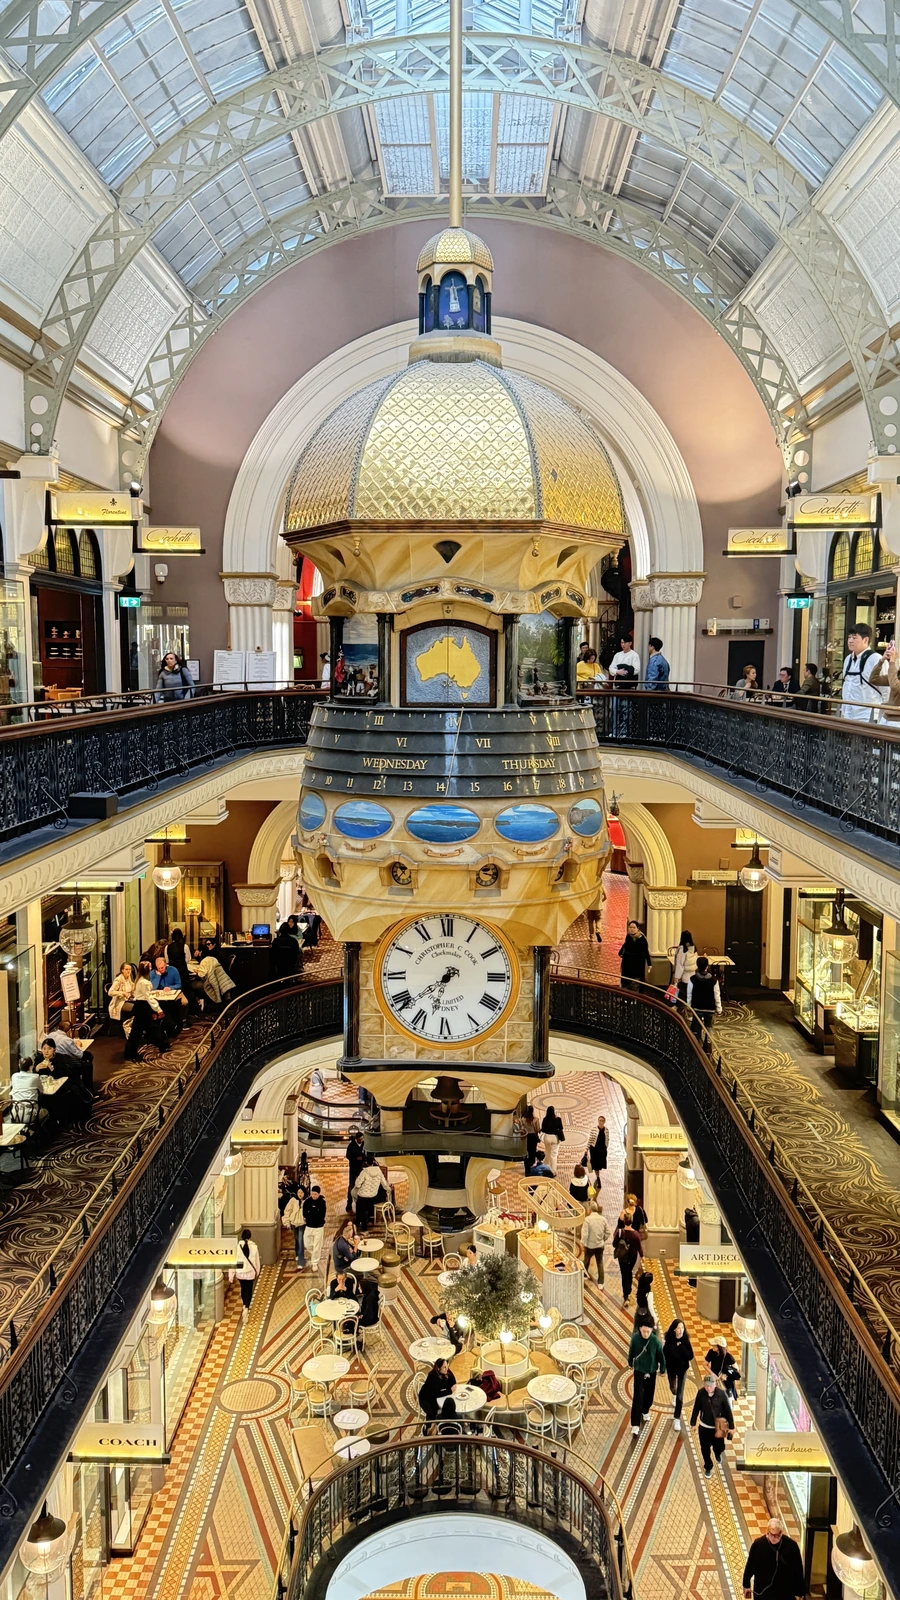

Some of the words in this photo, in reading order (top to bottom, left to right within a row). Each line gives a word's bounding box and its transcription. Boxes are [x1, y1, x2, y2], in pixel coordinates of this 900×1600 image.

[374, 716, 385, 726] III
[334, 735, 341, 744] V
[396, 738, 408, 748] VI
[475, 738, 491, 749] VII
[546, 736, 562, 748] VIII
[362, 757, 429, 770] WEDNESDAY
[502, 758, 556, 770] THURSDAY
[325, 775, 334, 786] 10
[346, 778, 355, 788] 11
[373, 780, 382, 790] 12
[402, 781, 413, 791] 13
[435, 782, 447, 792] 14
[470, 781, 481, 792] 15
[503, 781, 513, 792] 16
[558, 779, 567, 789] 18
[414, 923, 433, 944] XI
[440, 918, 455, 937] XII
[464, 926, 479, 943] I
[394, 944, 414, 959] X
[415, 942, 454, 965] CHRISTOPHER
[464, 949, 479, 966] COOK
[480, 946, 500, 960] II
[387, 969, 406, 981] IX
[487, 971, 506, 983] III
[442, 995, 465, 1005] LIMITED
[478, 991, 501, 1012] IIII
[411, 1007, 428, 1031] VII
[439, 1016, 452, 1035] VI
[467, 1012, 480, 1031] V
[690, 1253, 712, 1261] ART
[713, 1254, 741, 1262] DECO
[99, 1438, 157, 1446] COACH
